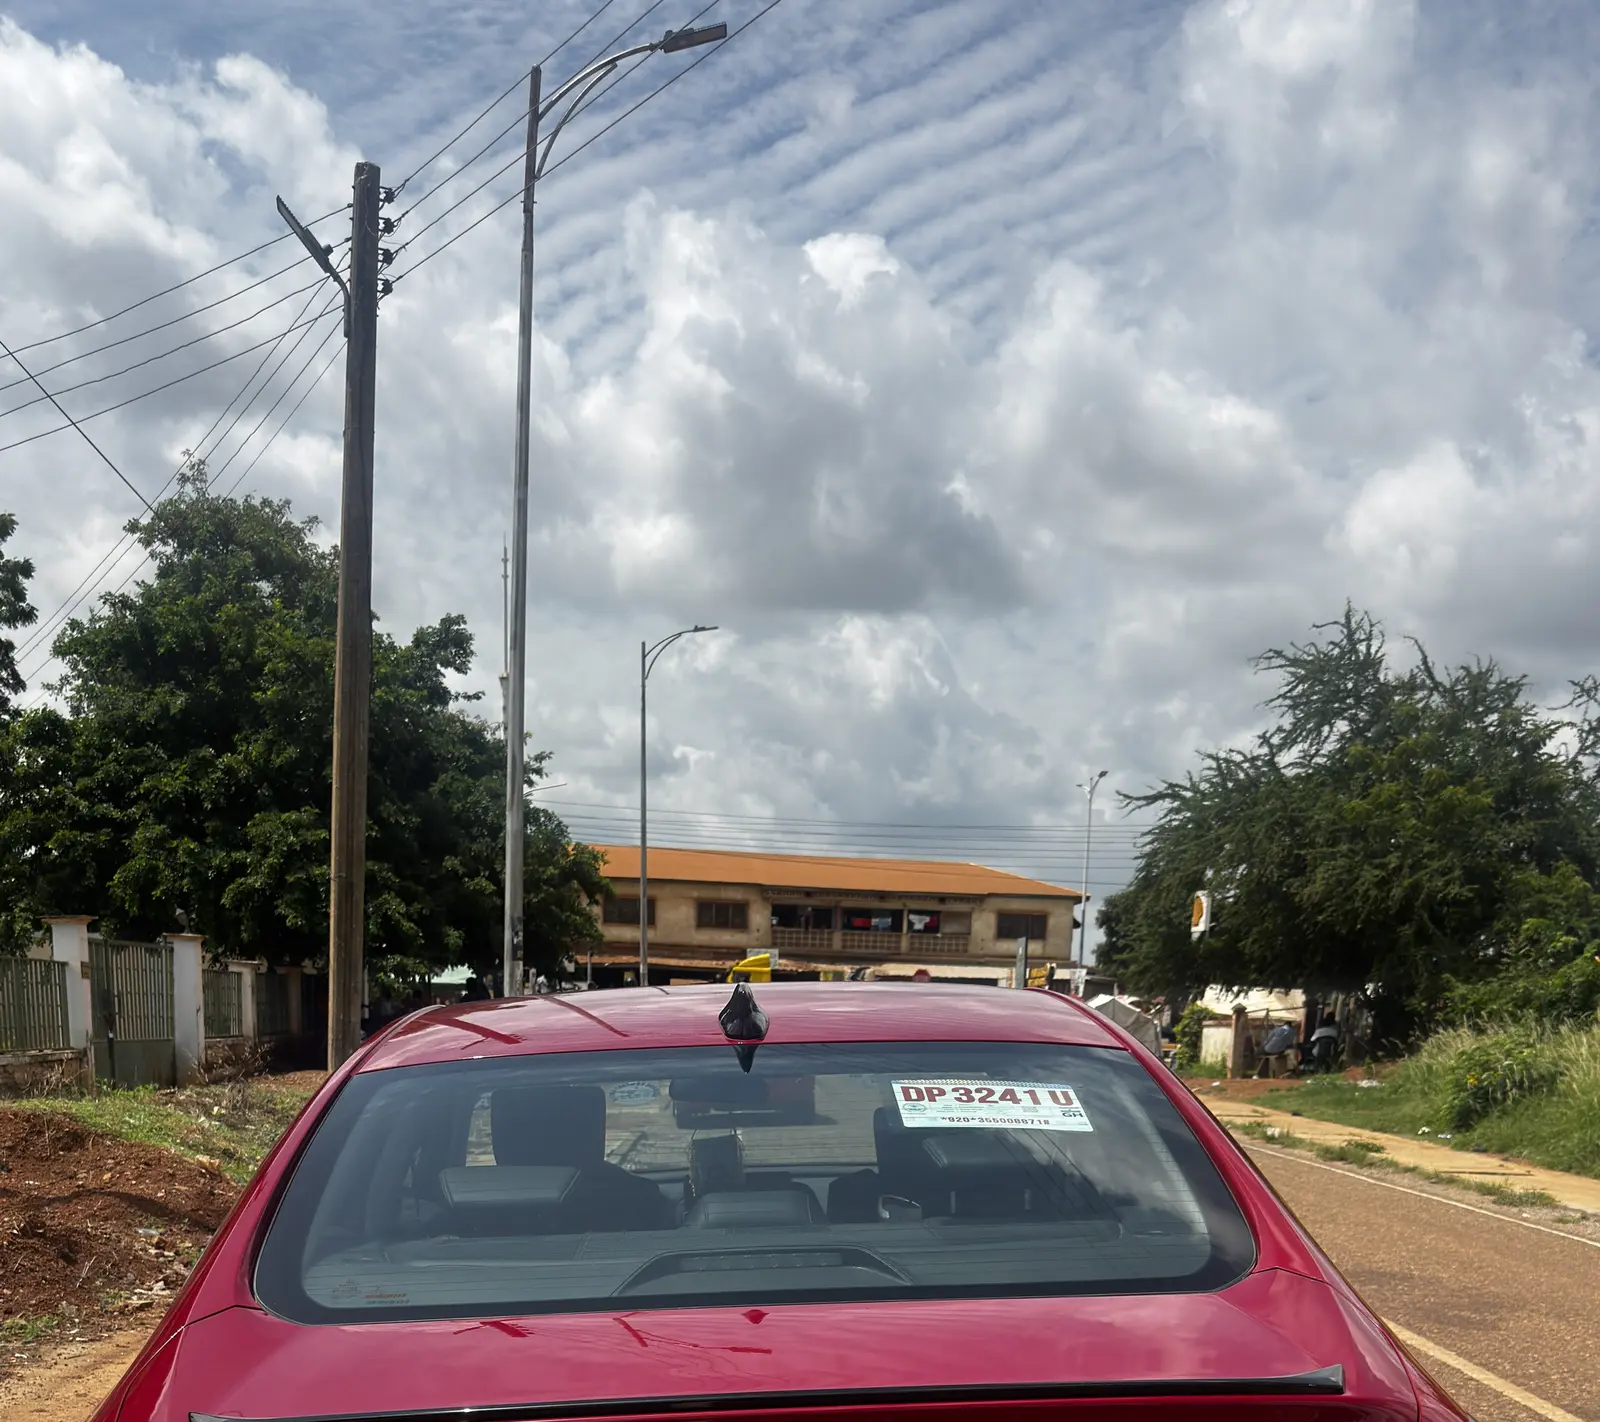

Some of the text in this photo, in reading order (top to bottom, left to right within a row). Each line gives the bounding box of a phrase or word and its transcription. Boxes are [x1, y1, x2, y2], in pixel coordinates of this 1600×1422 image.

[900, 1086, 1075, 1107] DP 3241 U
